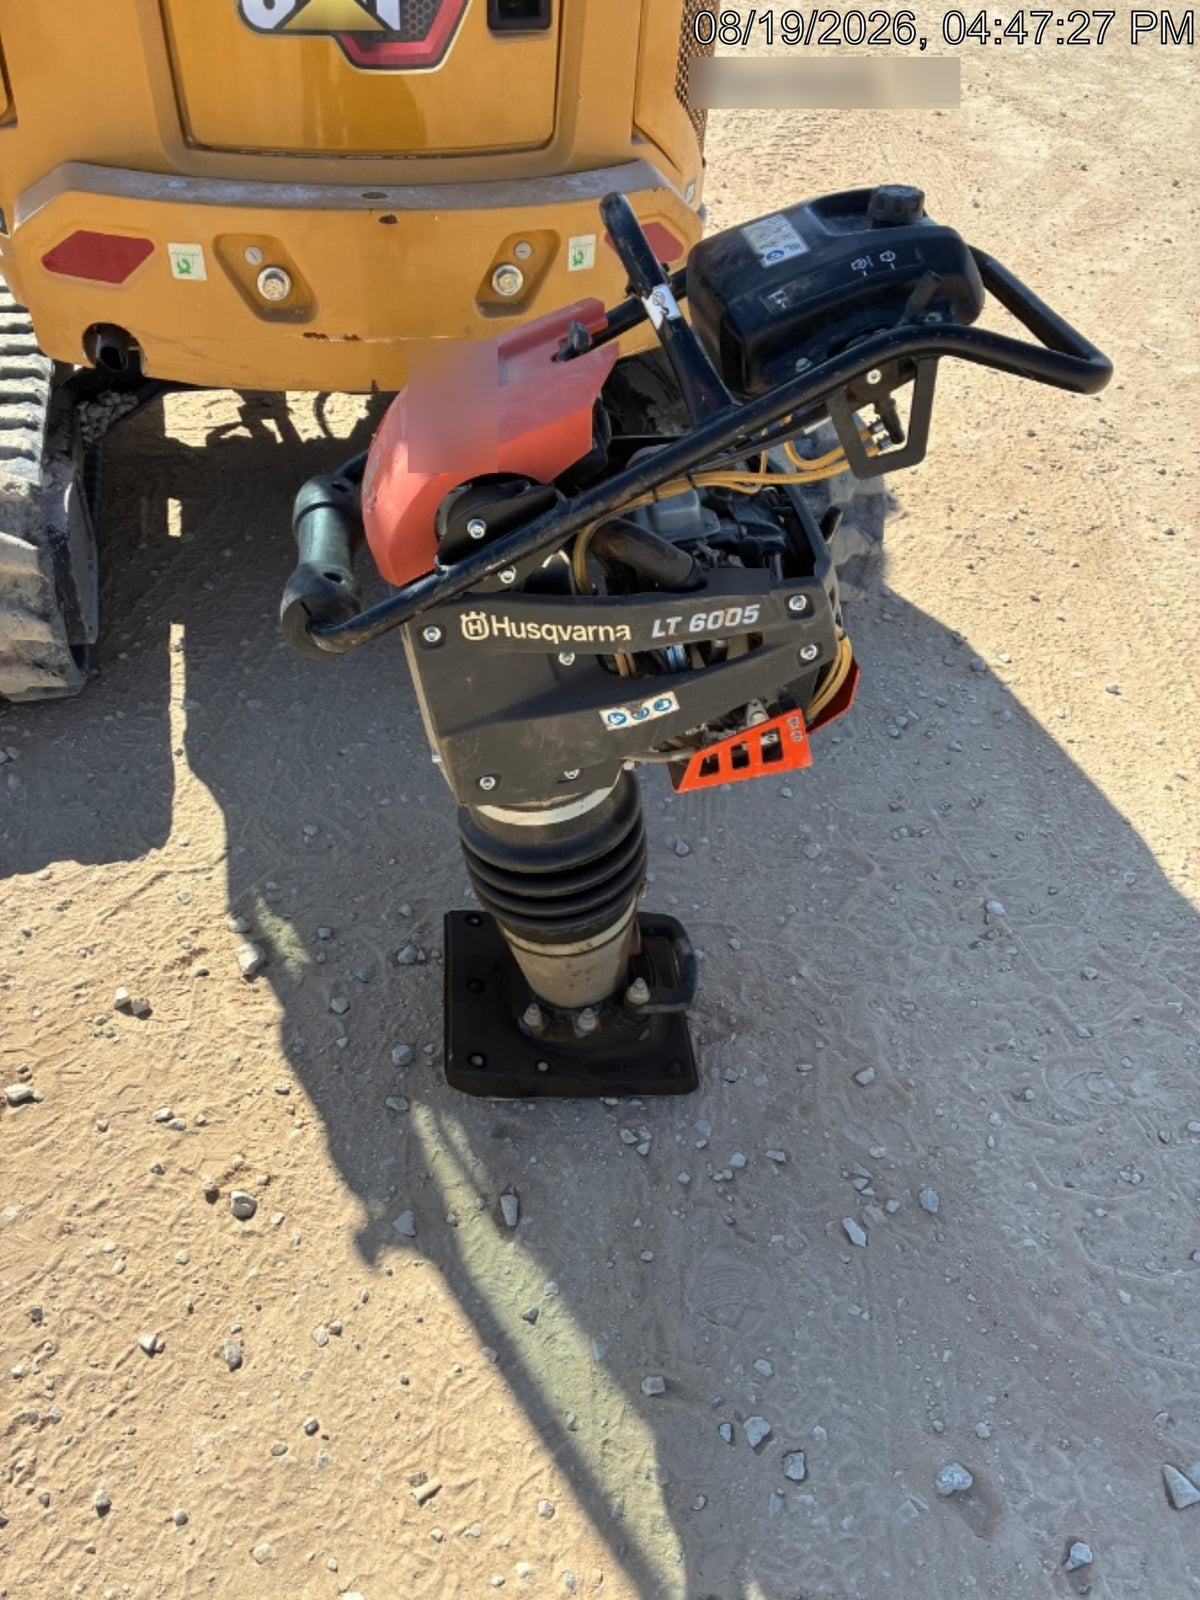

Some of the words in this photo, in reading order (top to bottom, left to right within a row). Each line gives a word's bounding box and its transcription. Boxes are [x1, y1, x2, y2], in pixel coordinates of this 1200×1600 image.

[490, 614, 632, 644] Husqvarna
[651, 616, 683, 638] LT
[689, 604, 761, 632] 6005
